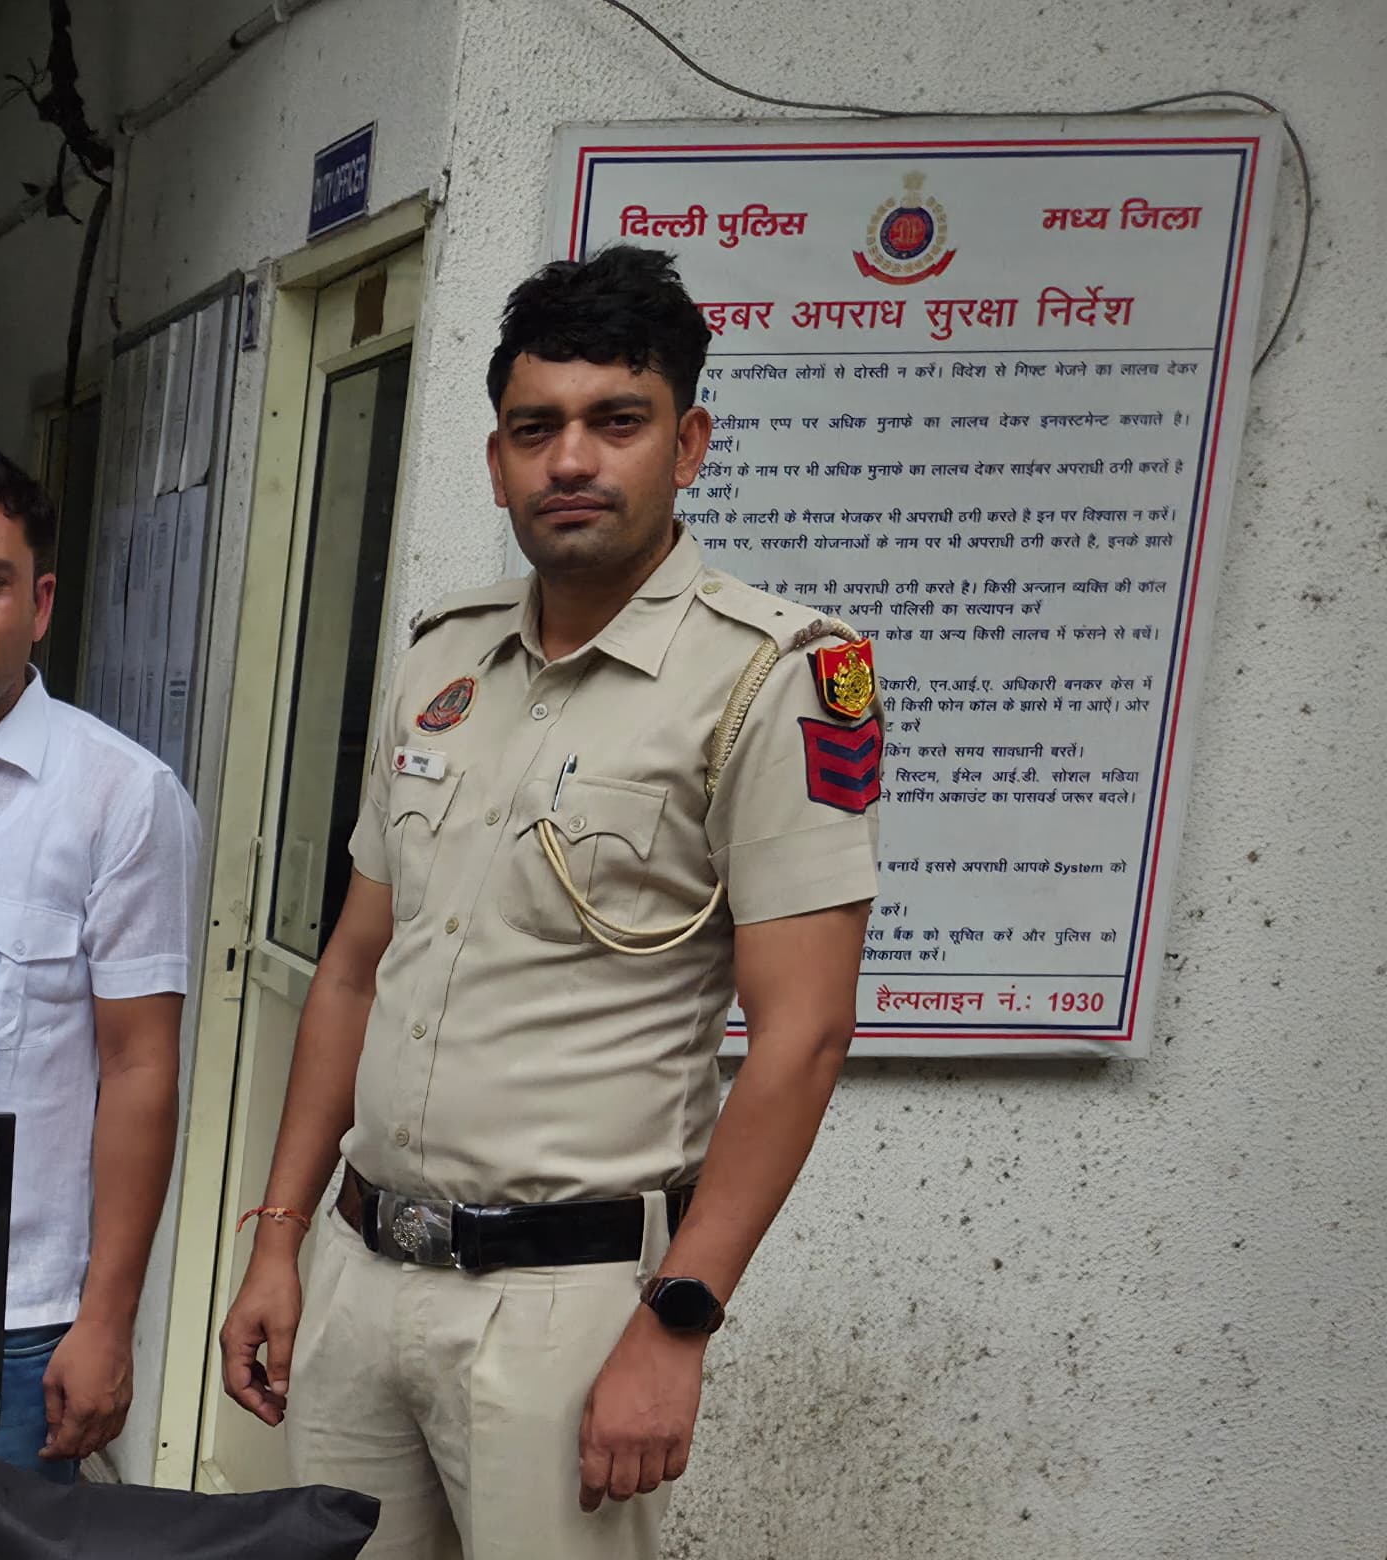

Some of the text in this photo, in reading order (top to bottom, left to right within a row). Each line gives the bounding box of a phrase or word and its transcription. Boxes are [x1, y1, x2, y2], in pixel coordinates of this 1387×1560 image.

[1043, 198, 1201, 230] मध्य जिला
[620, 204, 807, 248] दिल्ली पुलिस
[792, 297, 907, 330] अपराध
[924, 297, 1019, 341] सुरक्षा
[1038, 286, 1134, 325] निर्देश
[707, 360, 1198, 379] पर अपरिचित लोगों से दोस्ती न करें। विदेश से गिफ्ट भेजने का लालच देकर
[802, 418, 819, 429] पर
[828, 413, 867, 429] अधिक
[877, 413, 913, 433] मुनाफे
[923, 417, 940, 428] का
[951, 416, 989, 428] लालच
[1000, 412, 1030, 427] देकर
[1120, 411, 1163, 425] करवाते
[1174, 410, 1189, 426] है।
[737, 462, 750, 476] के
[755, 466, 778, 476] नाम
[784, 466, 800, 476] पर
[805, 461, 819, 476] भी
[824, 461, 862, 476] अधिक
[868, 461, 903, 480] मुनाफे
[909, 465, 926, 475] का
[931, 464, 969, 476] लालच
[975, 461, 1005, 476] देकर
[1057, 458, 1104, 474] अपराधी
[1109, 458, 1133, 474] ठगी
[1175, 459, 1183, 474] है
[1002, 675, 1057, 691] अधिकारी
[1064, 680, 1102, 690] बनकर
[1110, 675, 1134, 691] केस
[1142, 675, 1153, 690] में
[901, 697, 933, 712] किसी
[938, 697, 964, 712] फोन
[969, 699, 997, 711] कॉल
[1003, 697, 1015, 711] के
[1053, 696, 1063, 711] में
[1068, 699, 1082, 712] ना
[918, 742, 1083, 758] करते समय सावधानी बरतें।
[1013, 859, 1049, 873] आपके
[1053, 860, 1104, 876] System
[1110, 859, 1127, 873] को
[918, 947, 945, 961] करें।
[877, 983, 984, 1014] हैल्पलाइन
[1047, 991, 1104, 1013] 1930
